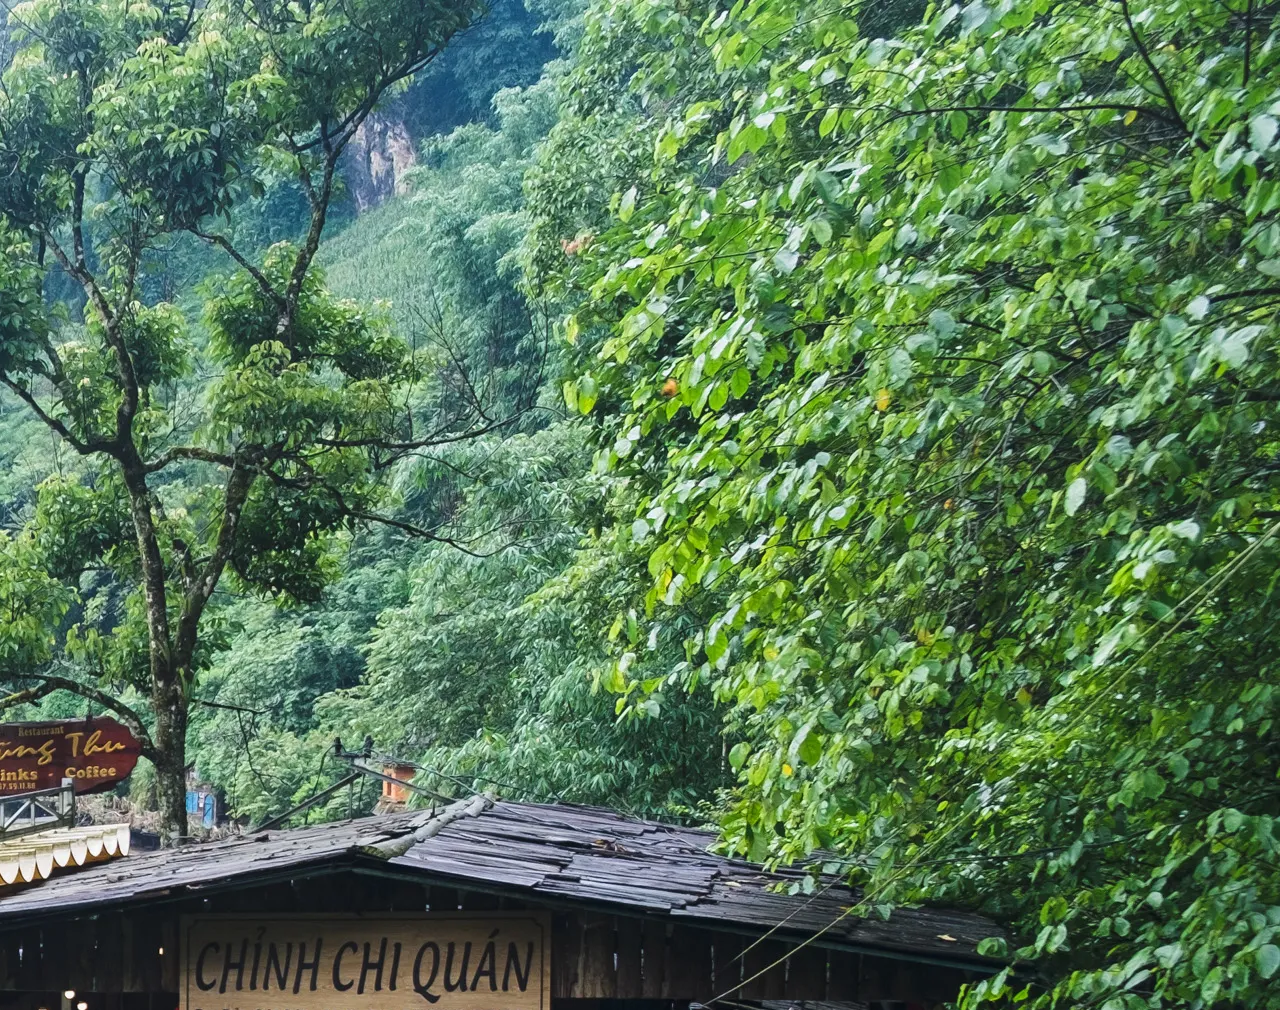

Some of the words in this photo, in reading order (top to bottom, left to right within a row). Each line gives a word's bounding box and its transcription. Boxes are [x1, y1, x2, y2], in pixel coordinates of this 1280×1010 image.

[18, 725, 65, 737] Restaurant
[64, 729, 126, 759] Thu
[65, 766, 117, 779] Coffee
[332, 937, 403, 995] CHI
[412, 928, 535, 1004] QUÁN
